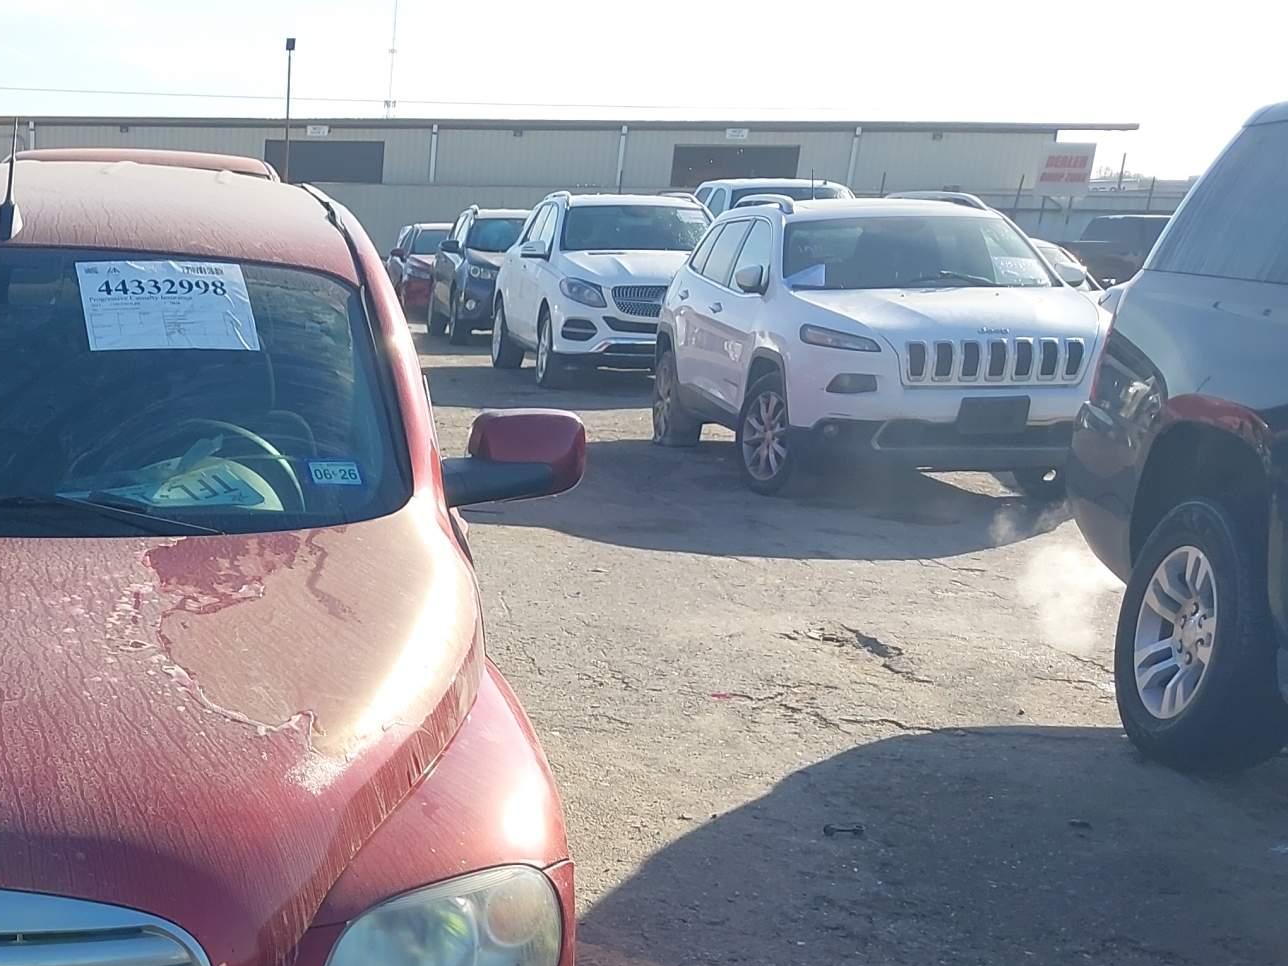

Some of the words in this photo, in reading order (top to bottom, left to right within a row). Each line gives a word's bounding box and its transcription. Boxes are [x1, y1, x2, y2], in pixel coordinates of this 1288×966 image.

[98, 279, 227, 296] 44332998
[313, 468, 333, 480] 06
[338, 468, 358, 480] 26
